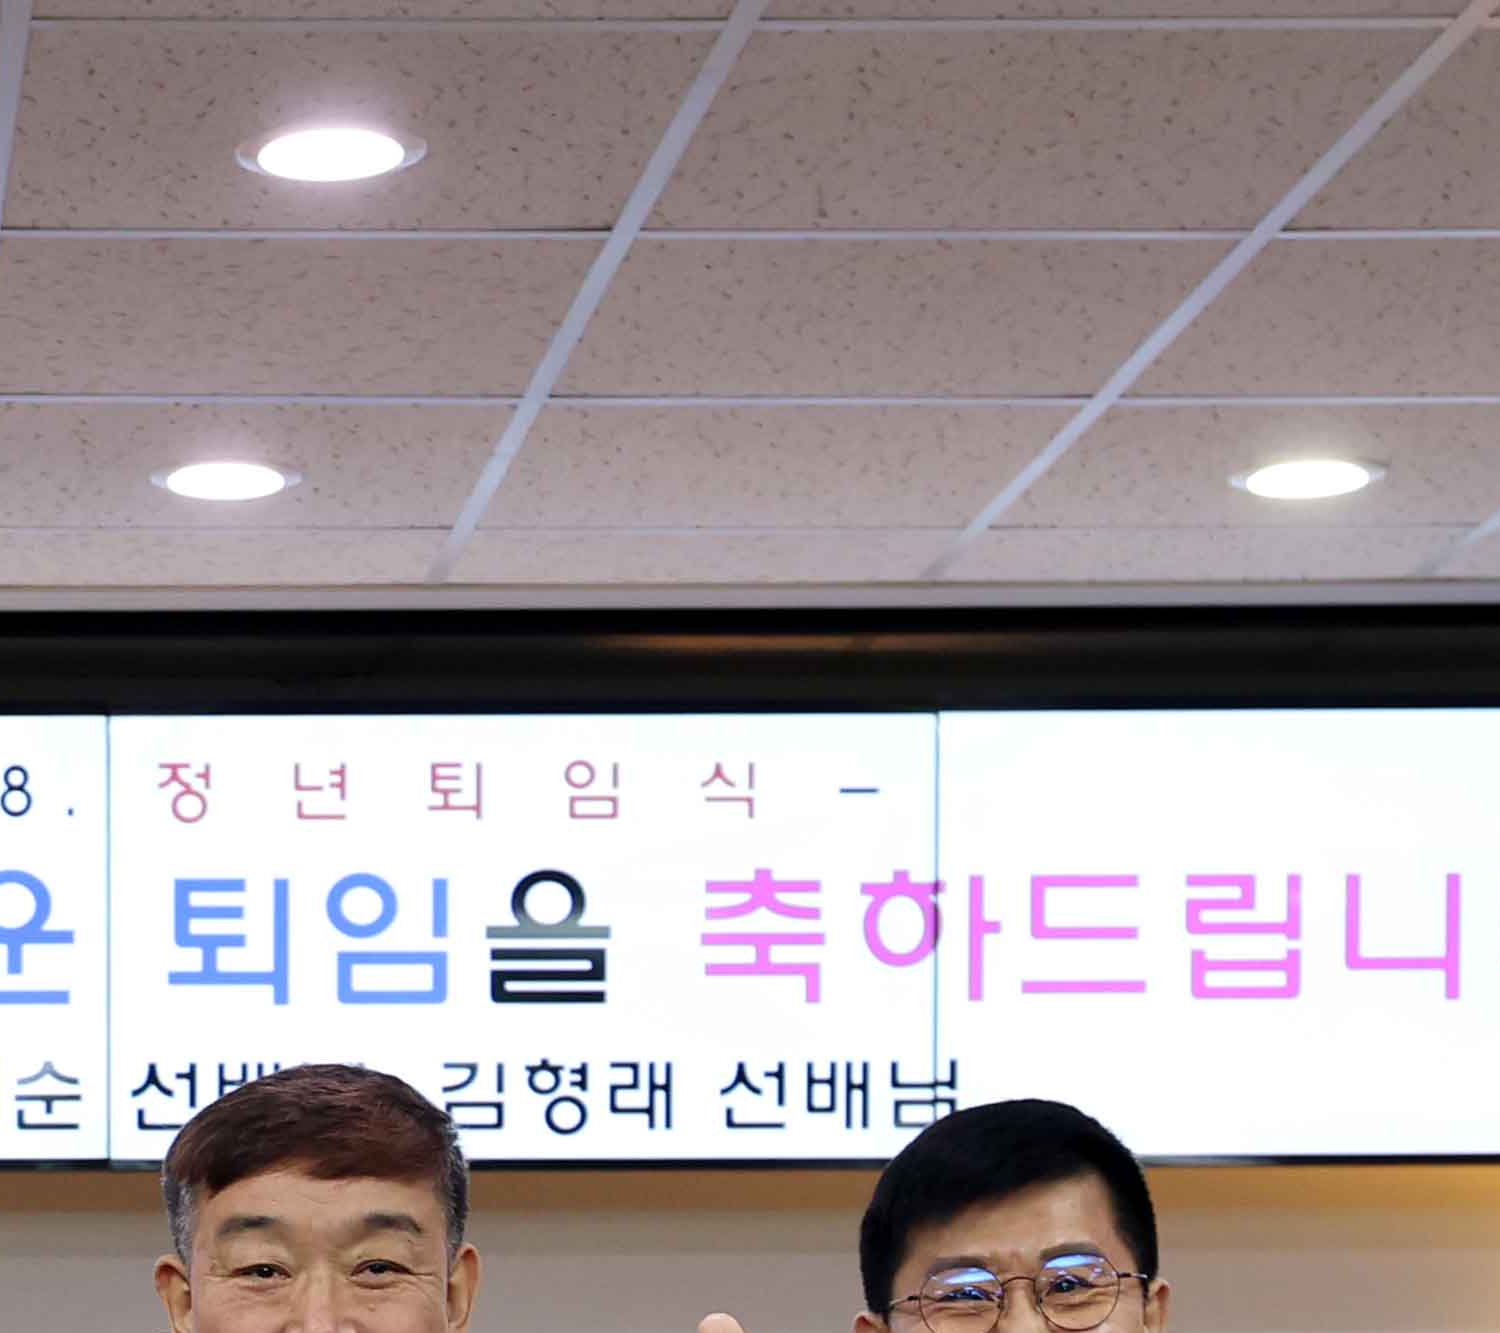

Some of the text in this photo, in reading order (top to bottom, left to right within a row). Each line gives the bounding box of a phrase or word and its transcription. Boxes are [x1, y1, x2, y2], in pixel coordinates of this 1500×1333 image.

[167, 868, 613, 1006] 퇴임을
[440, 1057, 674, 1137] 김형래
[719, 1058, 958, 1129] 선배님
